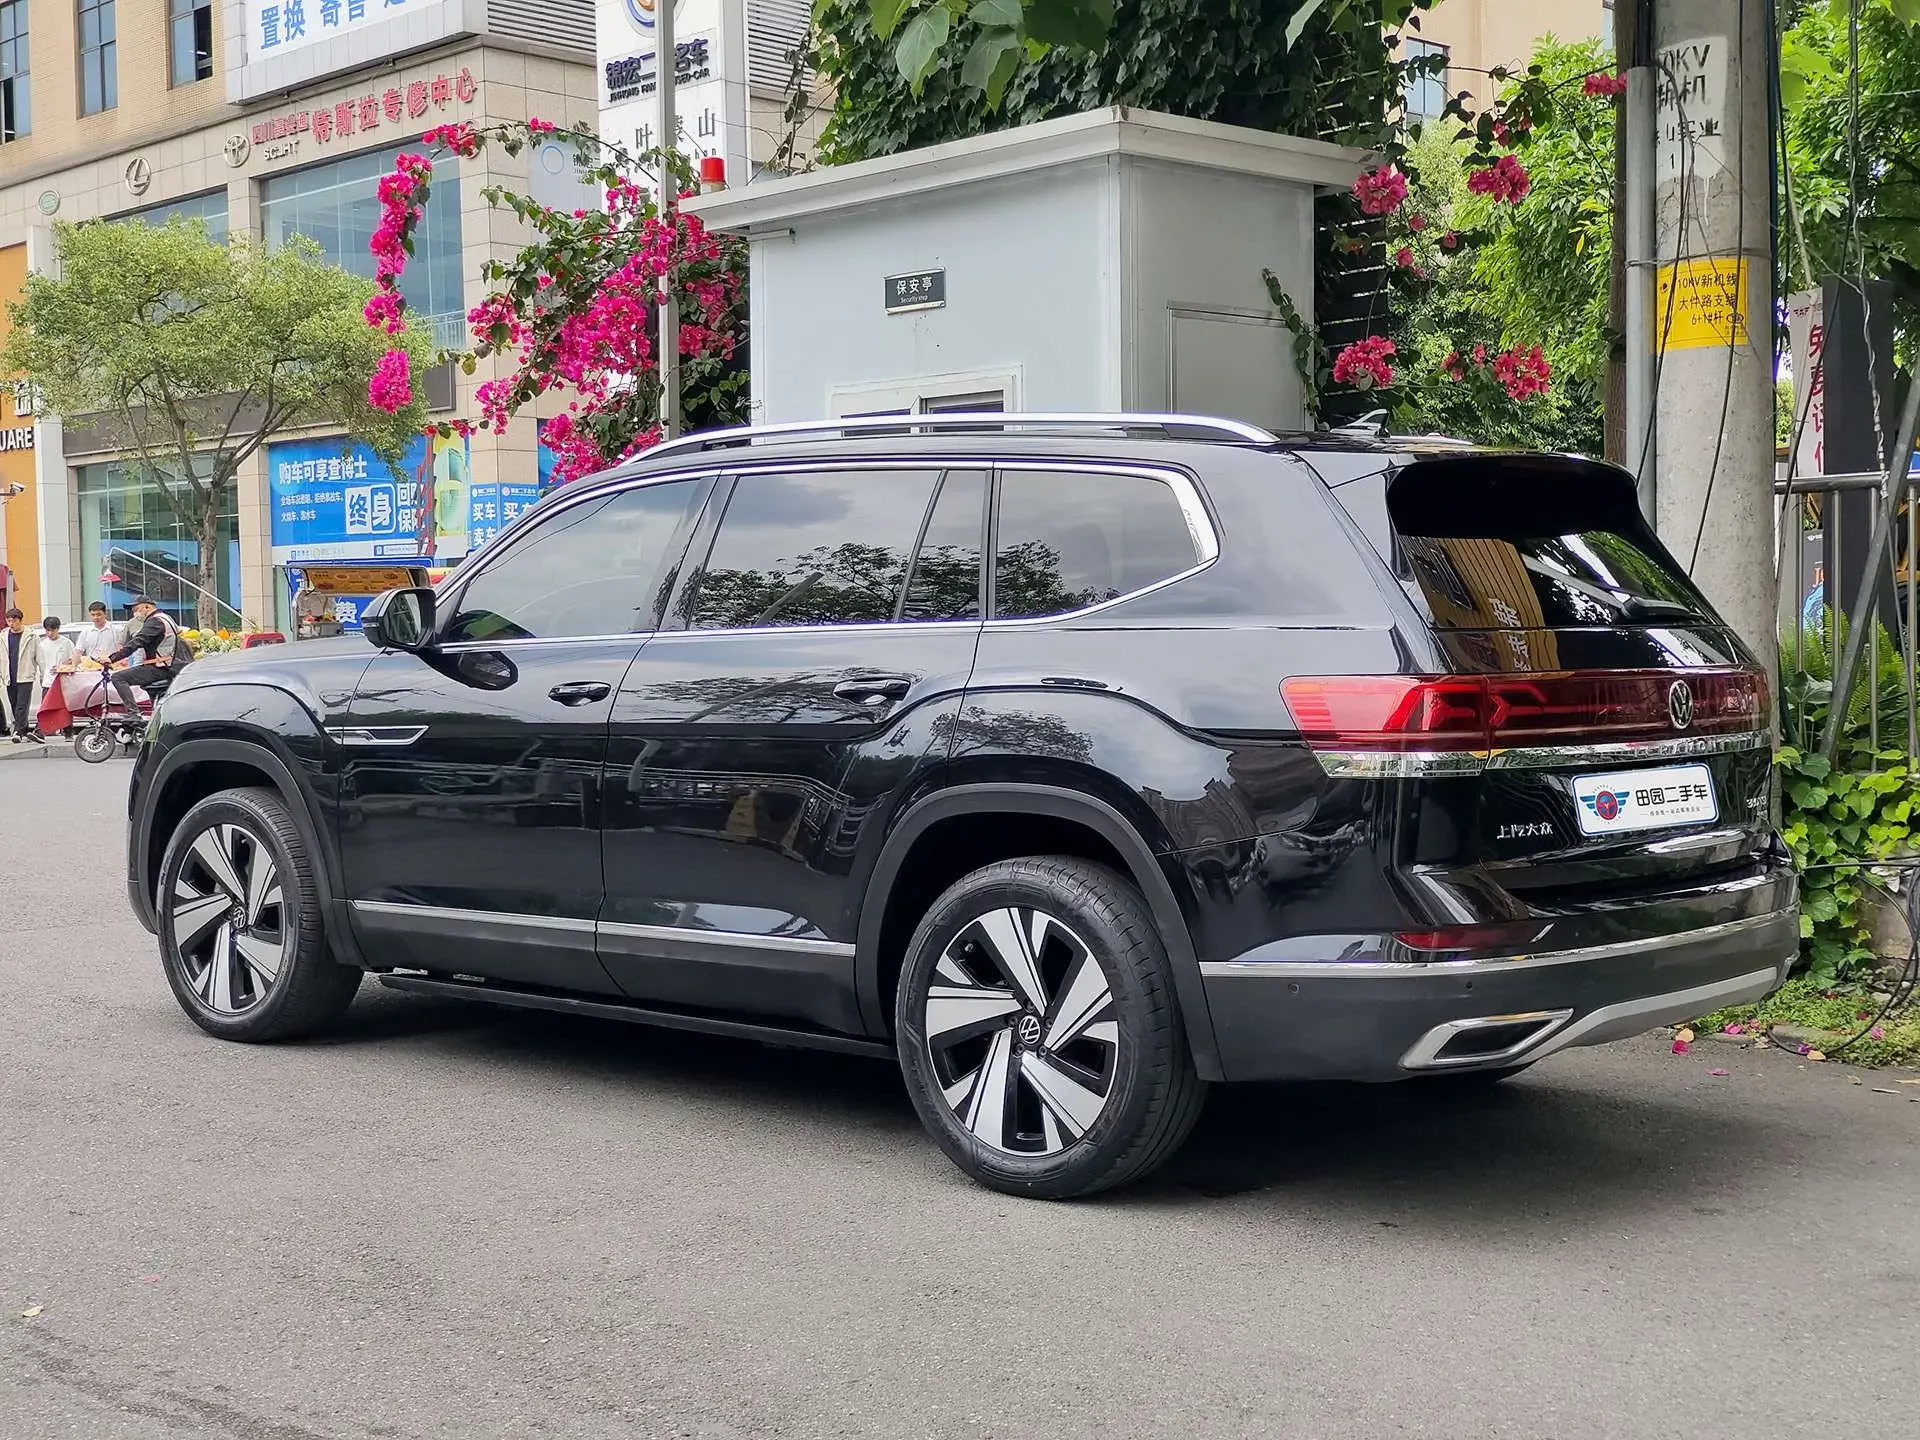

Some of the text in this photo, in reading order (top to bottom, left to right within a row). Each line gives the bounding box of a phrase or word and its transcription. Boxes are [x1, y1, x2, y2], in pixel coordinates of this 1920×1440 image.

[260, 5, 306, 50] 置换
[312, 67, 477, 144] 特斯拉专修中心
[897, 276, 933, 295] 保安亭
[279, 455, 368, 485] 购车可享查博士
[349, 491, 391, 526] 终身
[473, 501, 496, 521] 买车
[1635, 784, 1708, 806] 田园二手车
